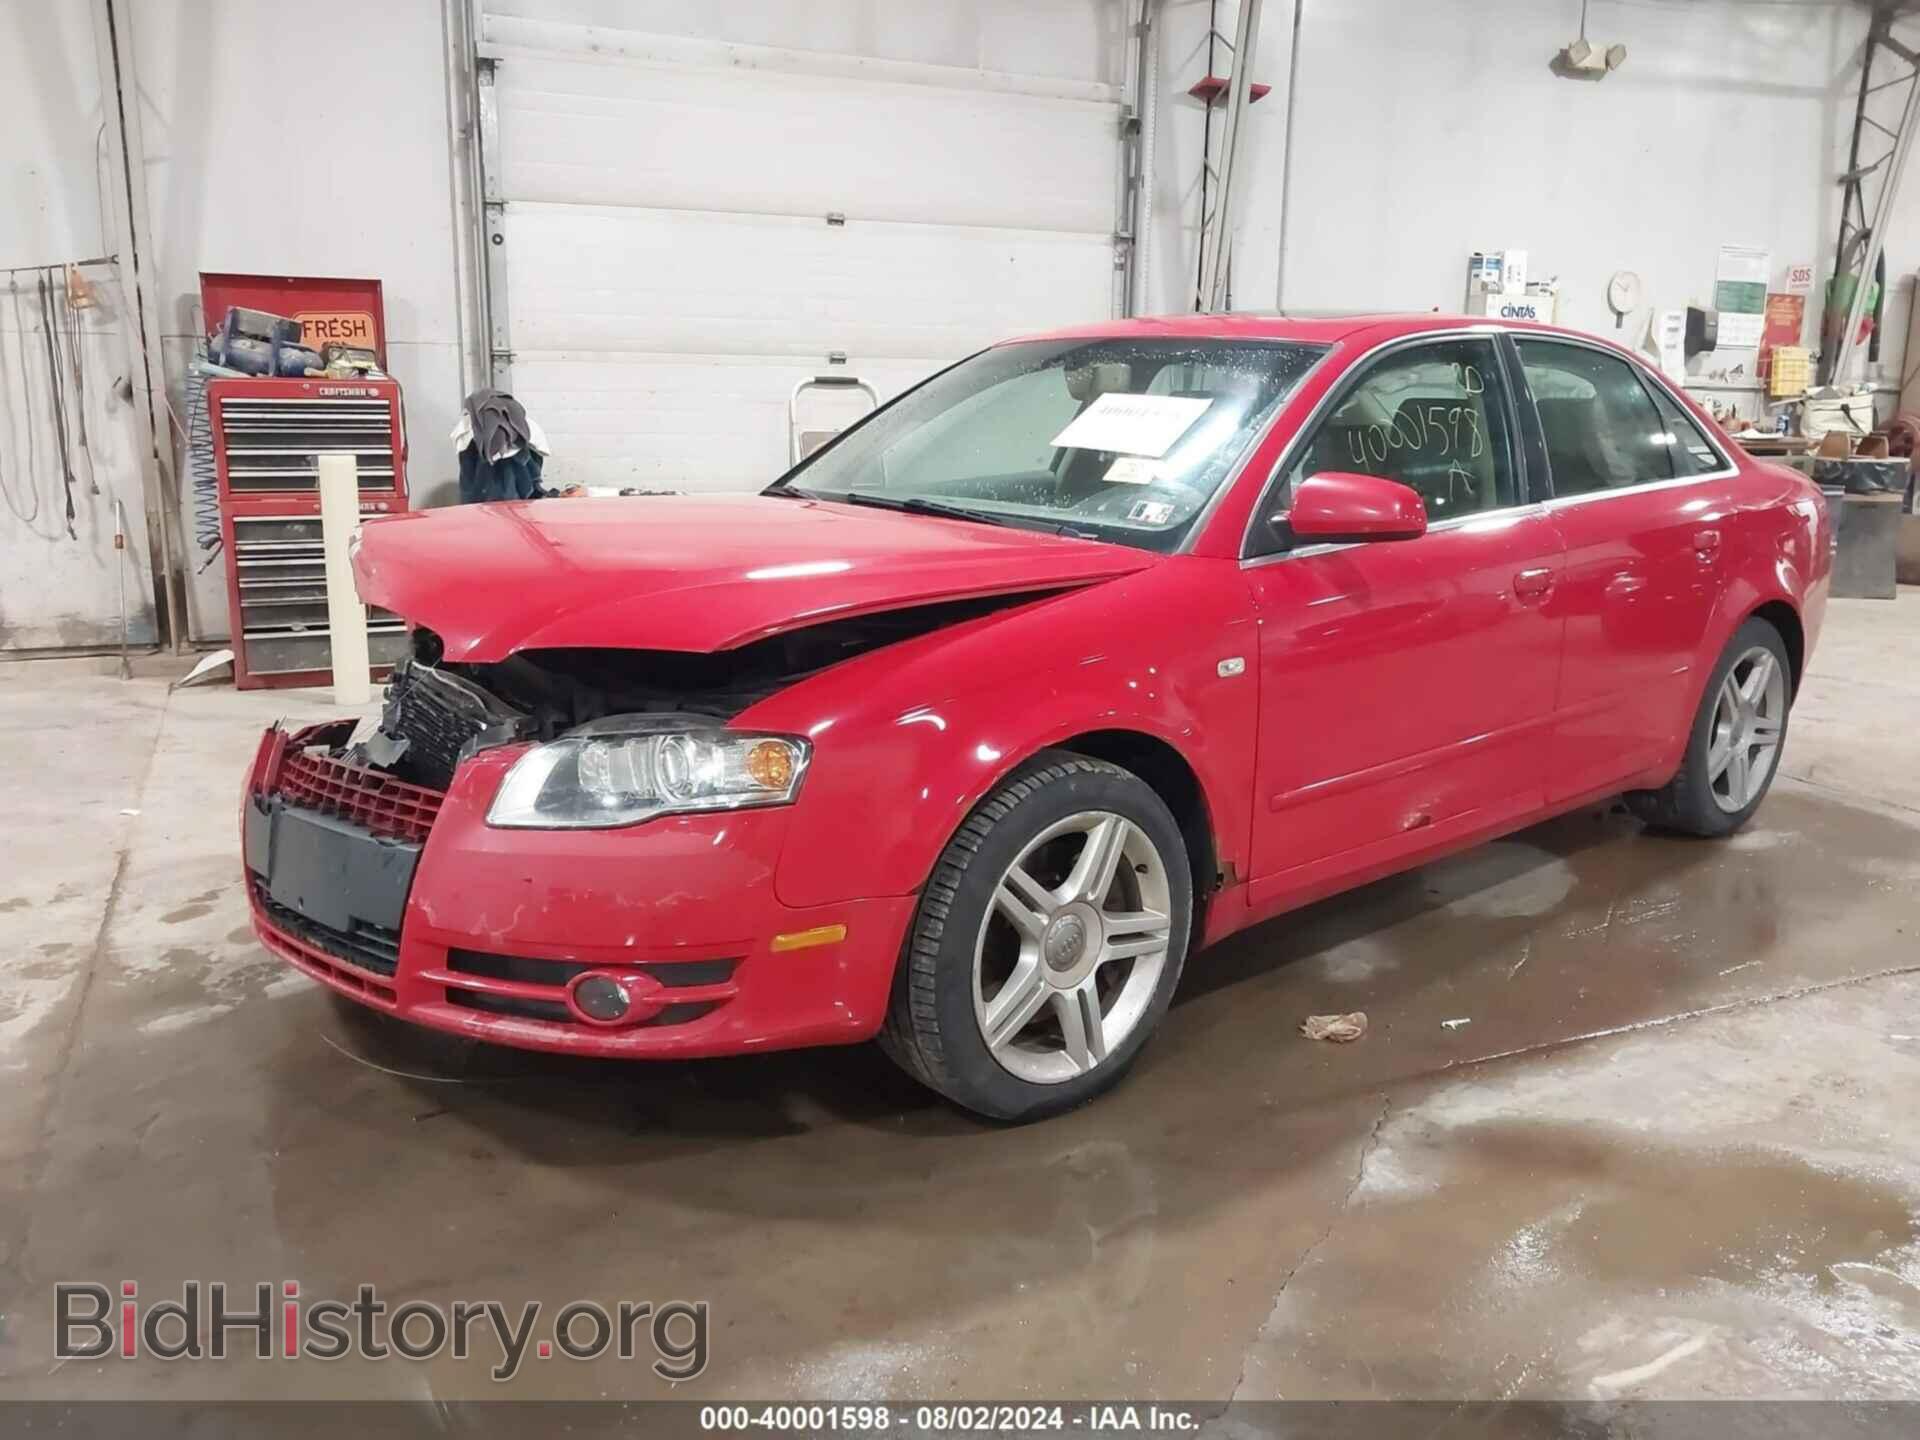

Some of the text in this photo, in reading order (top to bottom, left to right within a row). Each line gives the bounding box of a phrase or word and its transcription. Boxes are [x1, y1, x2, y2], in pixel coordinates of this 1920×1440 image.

[1792, 268, 1811, 282] SDS
[1501, 301, 1536, 319] CINTAS
[302, 319, 367, 338] FRESH
[1348, 404, 1483, 473] 40001598
[1448, 459, 1476, 503] A
